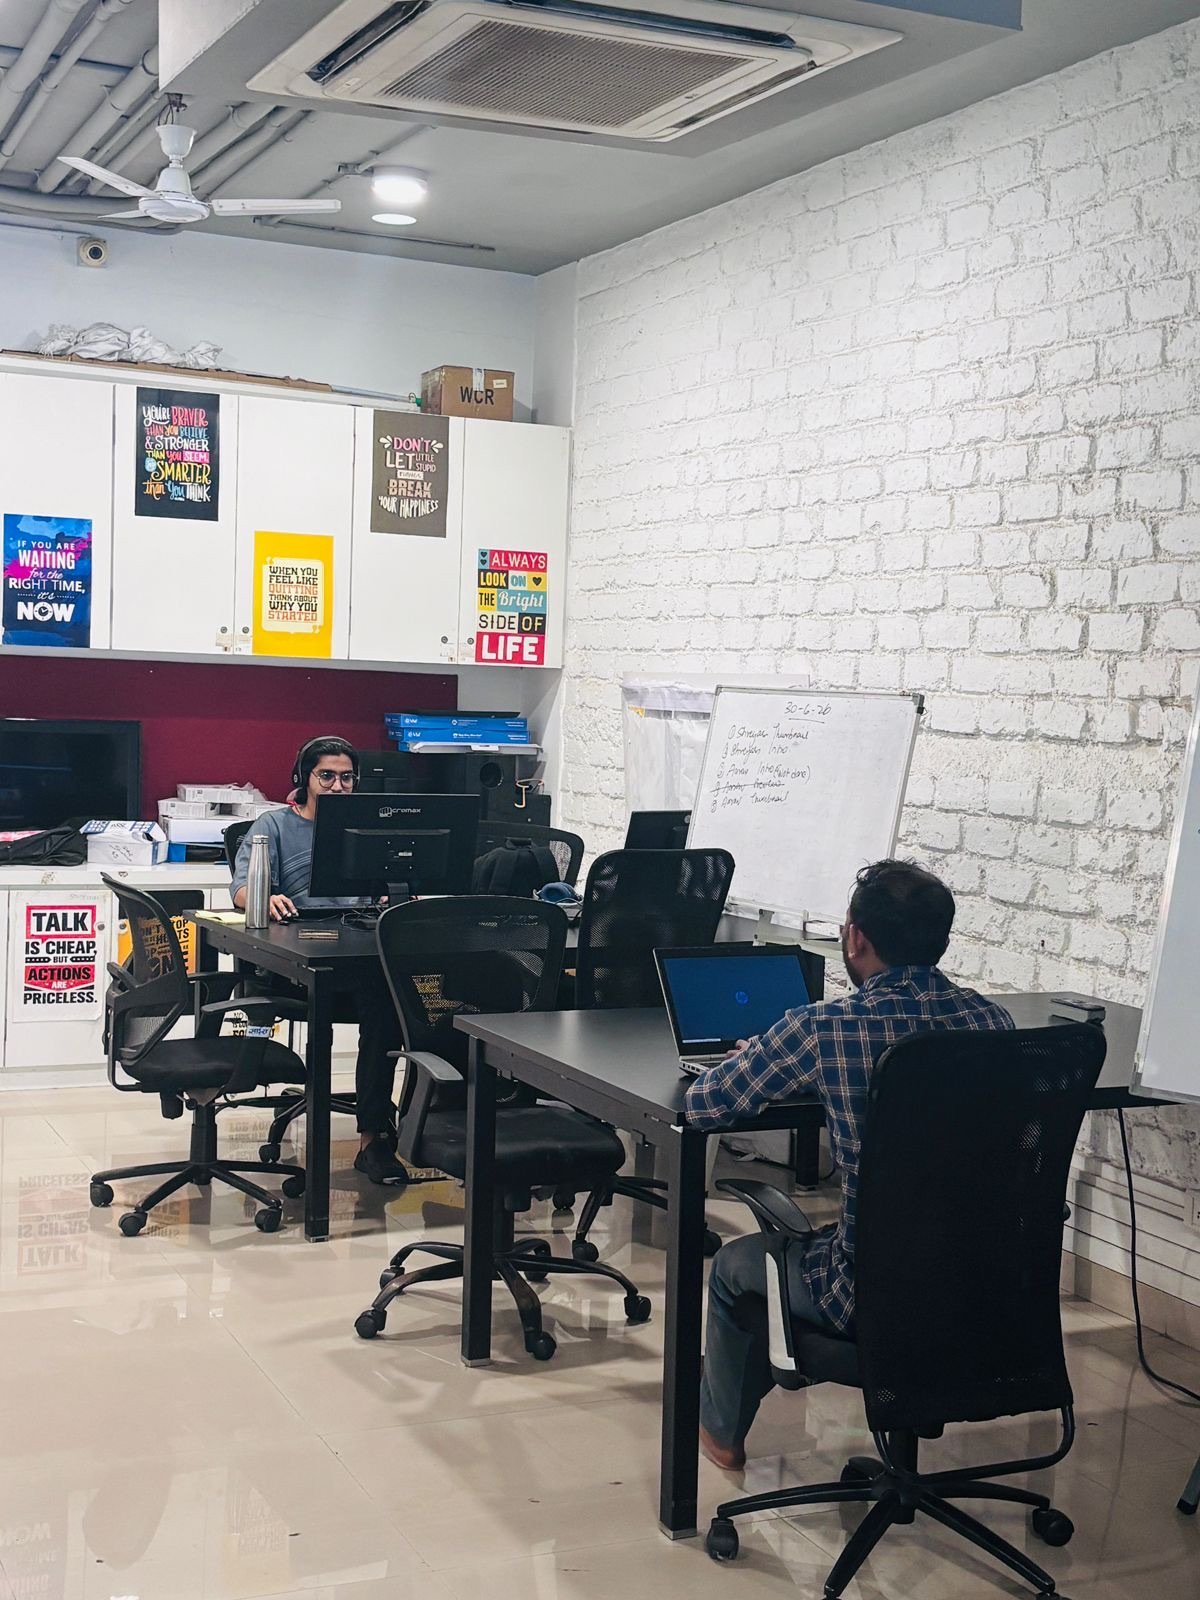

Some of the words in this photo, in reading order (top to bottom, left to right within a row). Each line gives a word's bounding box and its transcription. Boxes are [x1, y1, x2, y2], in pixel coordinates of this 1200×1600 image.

[460, 386, 494, 405] WCR
[171, 406, 208, 427] BRAVER
[145, 425, 164, 436] THAN
[155, 434, 209, 451] STRONGER
[394, 437, 431, 453] DON'T
[146, 450, 165, 460] THAN
[386, 451, 415, 470] LET
[415, 453, 434, 462] LITTLE
[151, 461, 211, 485] SMARTER
[416, 463, 436, 473] STUPID
[388, 479, 432, 498] BREAK
[379, 495, 398, 513] YOUR
[399, 498, 439, 519] HAPPINESS
[31, 541, 52, 549] YOU
[56, 543, 75, 551] ARE
[18, 550, 75, 570] WAITING
[492, 553, 546, 569] ALWAYS
[29, 567, 45, 580] for
[46, 570, 63, 580] the
[269, 566, 298, 576] WHEN
[300, 568, 318, 577] YOU
[480, 571, 507, 587] LOOK
[511, 575, 526, 587] ON
[9, 578, 48, 590] RIGHT
[51, 580, 86, 594] TIME,
[269, 575, 294, 584] FEEL
[296, 576, 318, 586] LIKE
[37, 592, 56, 600] it's
[268, 584, 318, 595] QUITTING
[269, 601, 295, 611] WHY
[297, 602, 318, 612] YOU
[294, 595, 318, 603] ABOUT
[479, 592, 495, 606] THE
[499, 591, 544, 611] Bright
[17, 601, 75, 622] NOW
[268, 611, 318, 622] STARTED
[479, 614, 516, 630] SIDE
[522, 616, 543, 631] OF
[482, 634, 538, 661] LIFE
[32, 912, 88, 932] TALK
[25, 941, 40, 954] IS
[46, 940, 97, 955] CHEAP,
[28, 967, 91, 980] ACTIONS
[52, 981, 67, 989] ARE
[24, 991, 98, 1004] PRICELESS.
